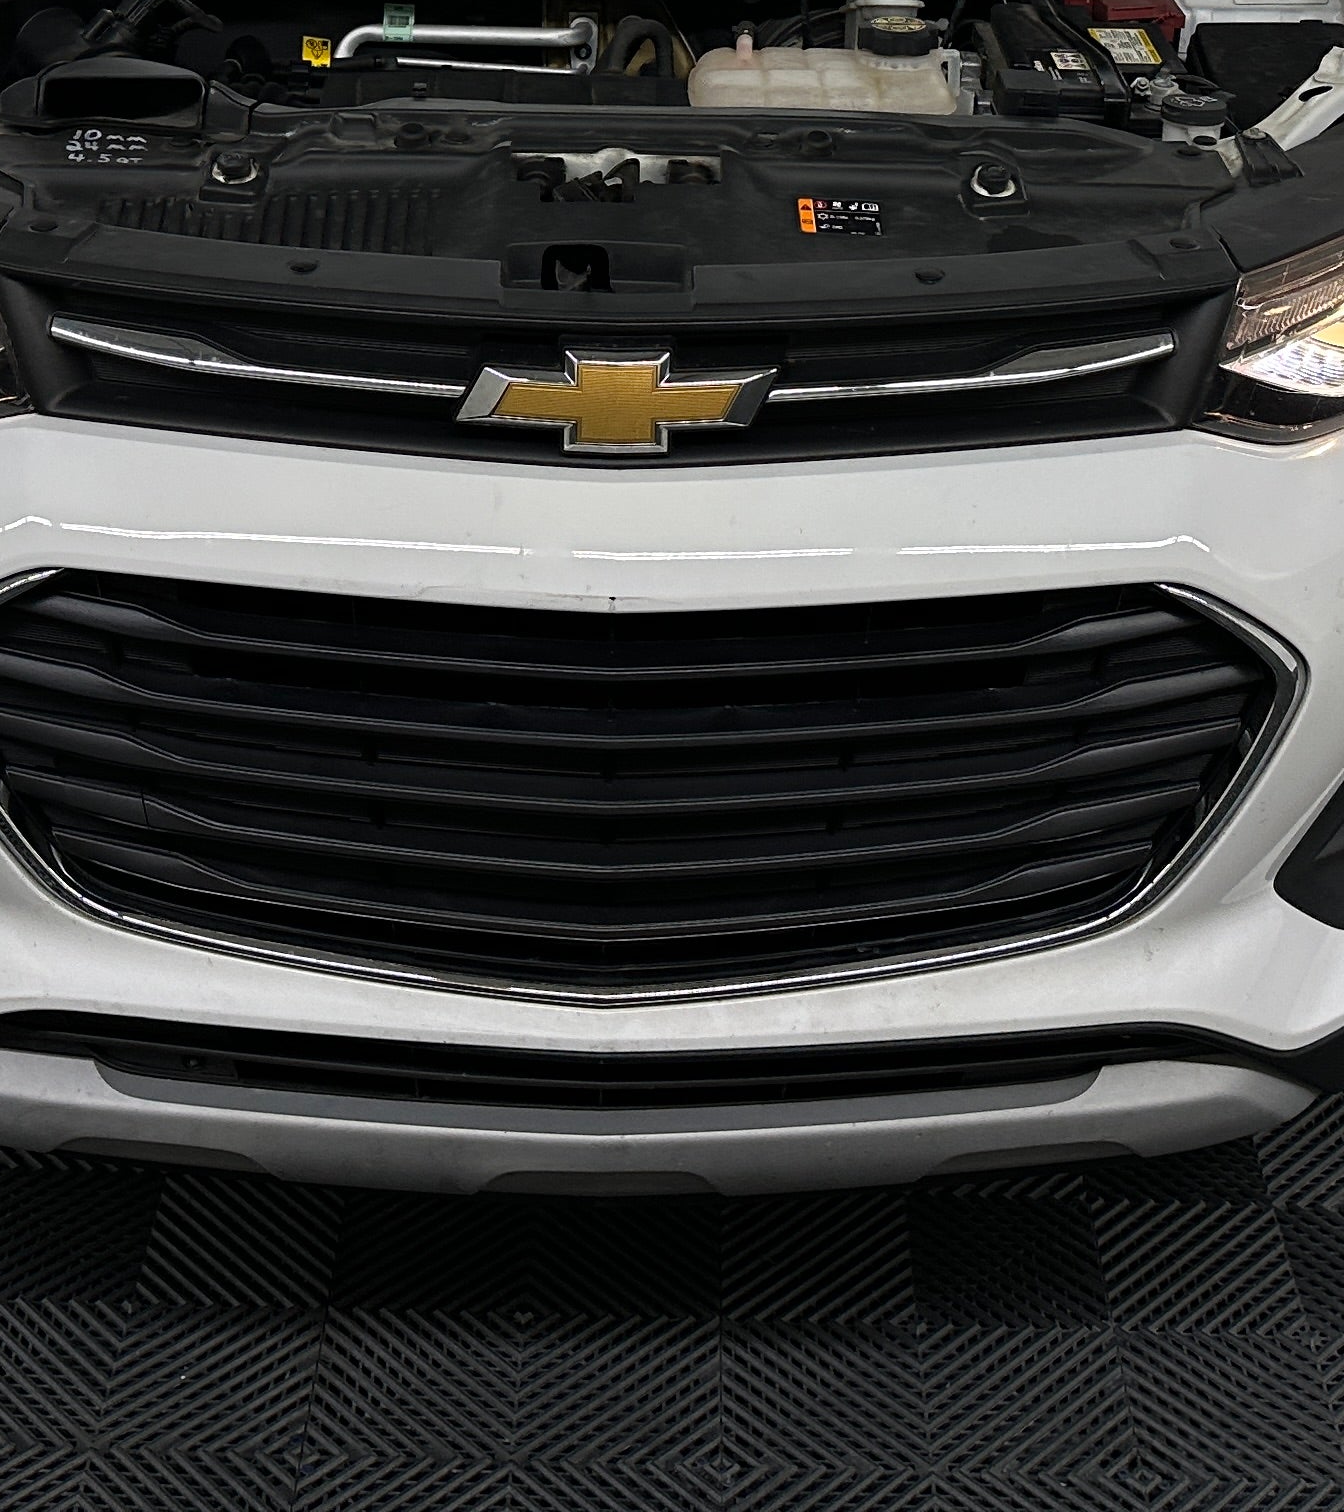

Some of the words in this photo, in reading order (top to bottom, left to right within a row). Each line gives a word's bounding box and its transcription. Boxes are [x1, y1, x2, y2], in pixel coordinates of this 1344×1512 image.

[72, 129, 103, 141] 10
[65, 139, 99, 151] 24
[68, 152, 113, 163] 4.5
